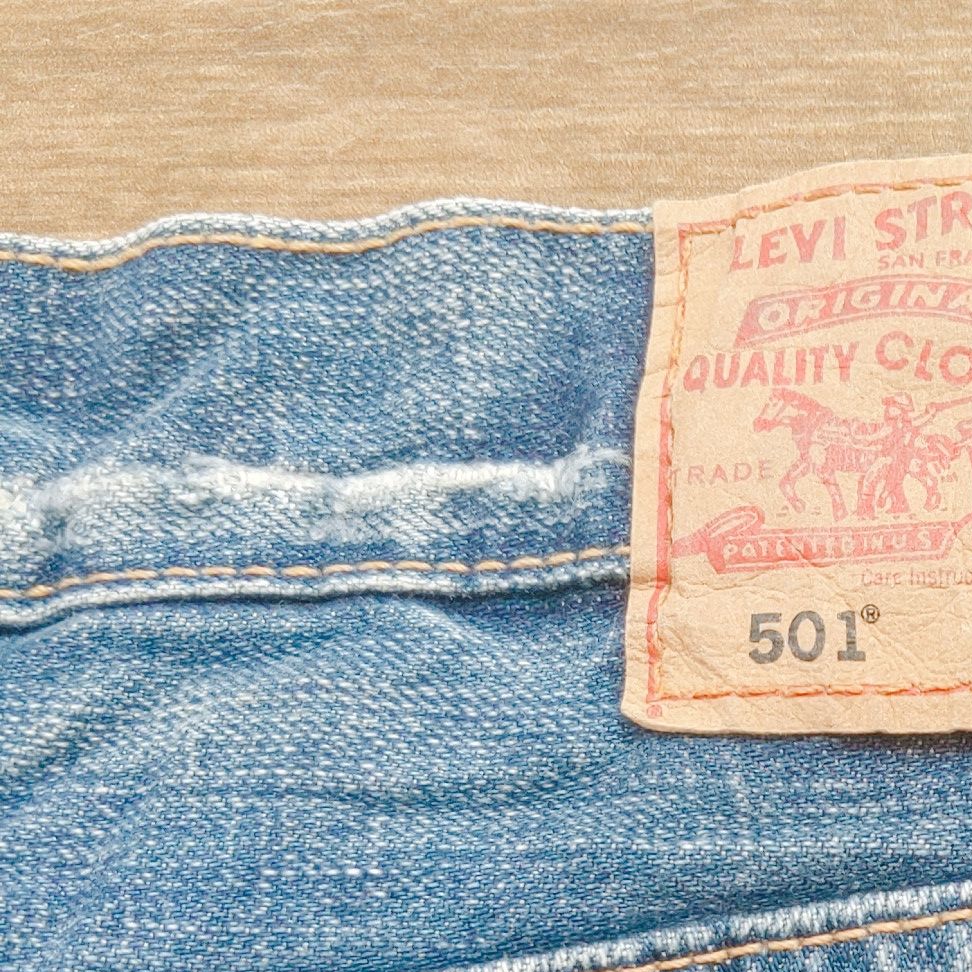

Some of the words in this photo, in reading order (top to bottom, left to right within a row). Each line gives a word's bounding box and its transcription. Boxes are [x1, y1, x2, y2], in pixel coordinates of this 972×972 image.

[729, 216, 846, 272] LEVI
[877, 253, 925, 271] SAN
[682, 340, 859, 393] QUALITY
